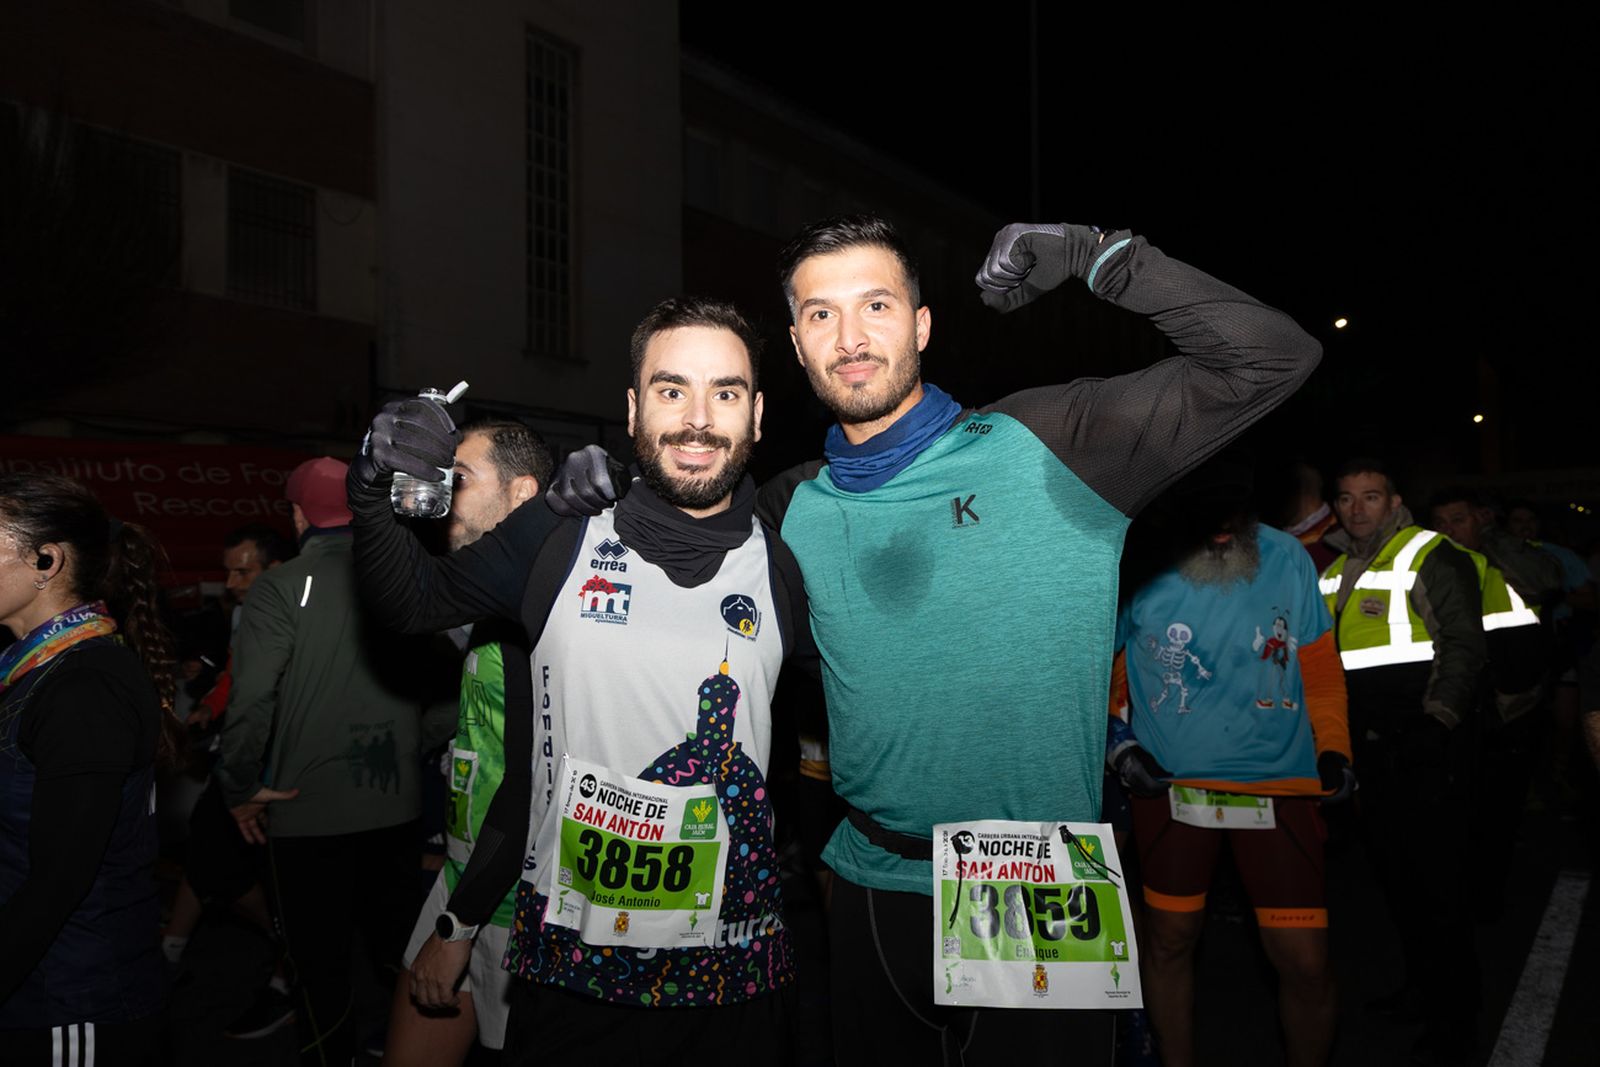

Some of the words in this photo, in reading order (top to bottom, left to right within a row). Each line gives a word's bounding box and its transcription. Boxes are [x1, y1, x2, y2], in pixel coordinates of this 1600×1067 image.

[178, 462, 232, 486] de
[133, 490, 289, 517] Rescate
[953, 494, 980, 525] K
[580, 779, 596, 794] 43
[631, 791, 669, 804] INTERNACIONAL
[596, 787, 641, 817] NOCHE
[644, 803, 669, 820] DE
[573, 802, 610, 831] SAN
[606, 813, 665, 842] ANTÓN
[977, 832, 1000, 840] CARRERA
[1001, 832, 1021, 840] URBANA
[978, 839, 1032, 858] NOCHE
[576, 828, 695, 893] 3858
[955, 860, 993, 881] SAN
[996, 860, 1056, 883] ANTÓN
[591, 890, 615, 906] José
[618, 894, 661, 908] Antonio
[969, 883, 1101, 942] 3859
[1015, 944, 1059, 961] Enique
